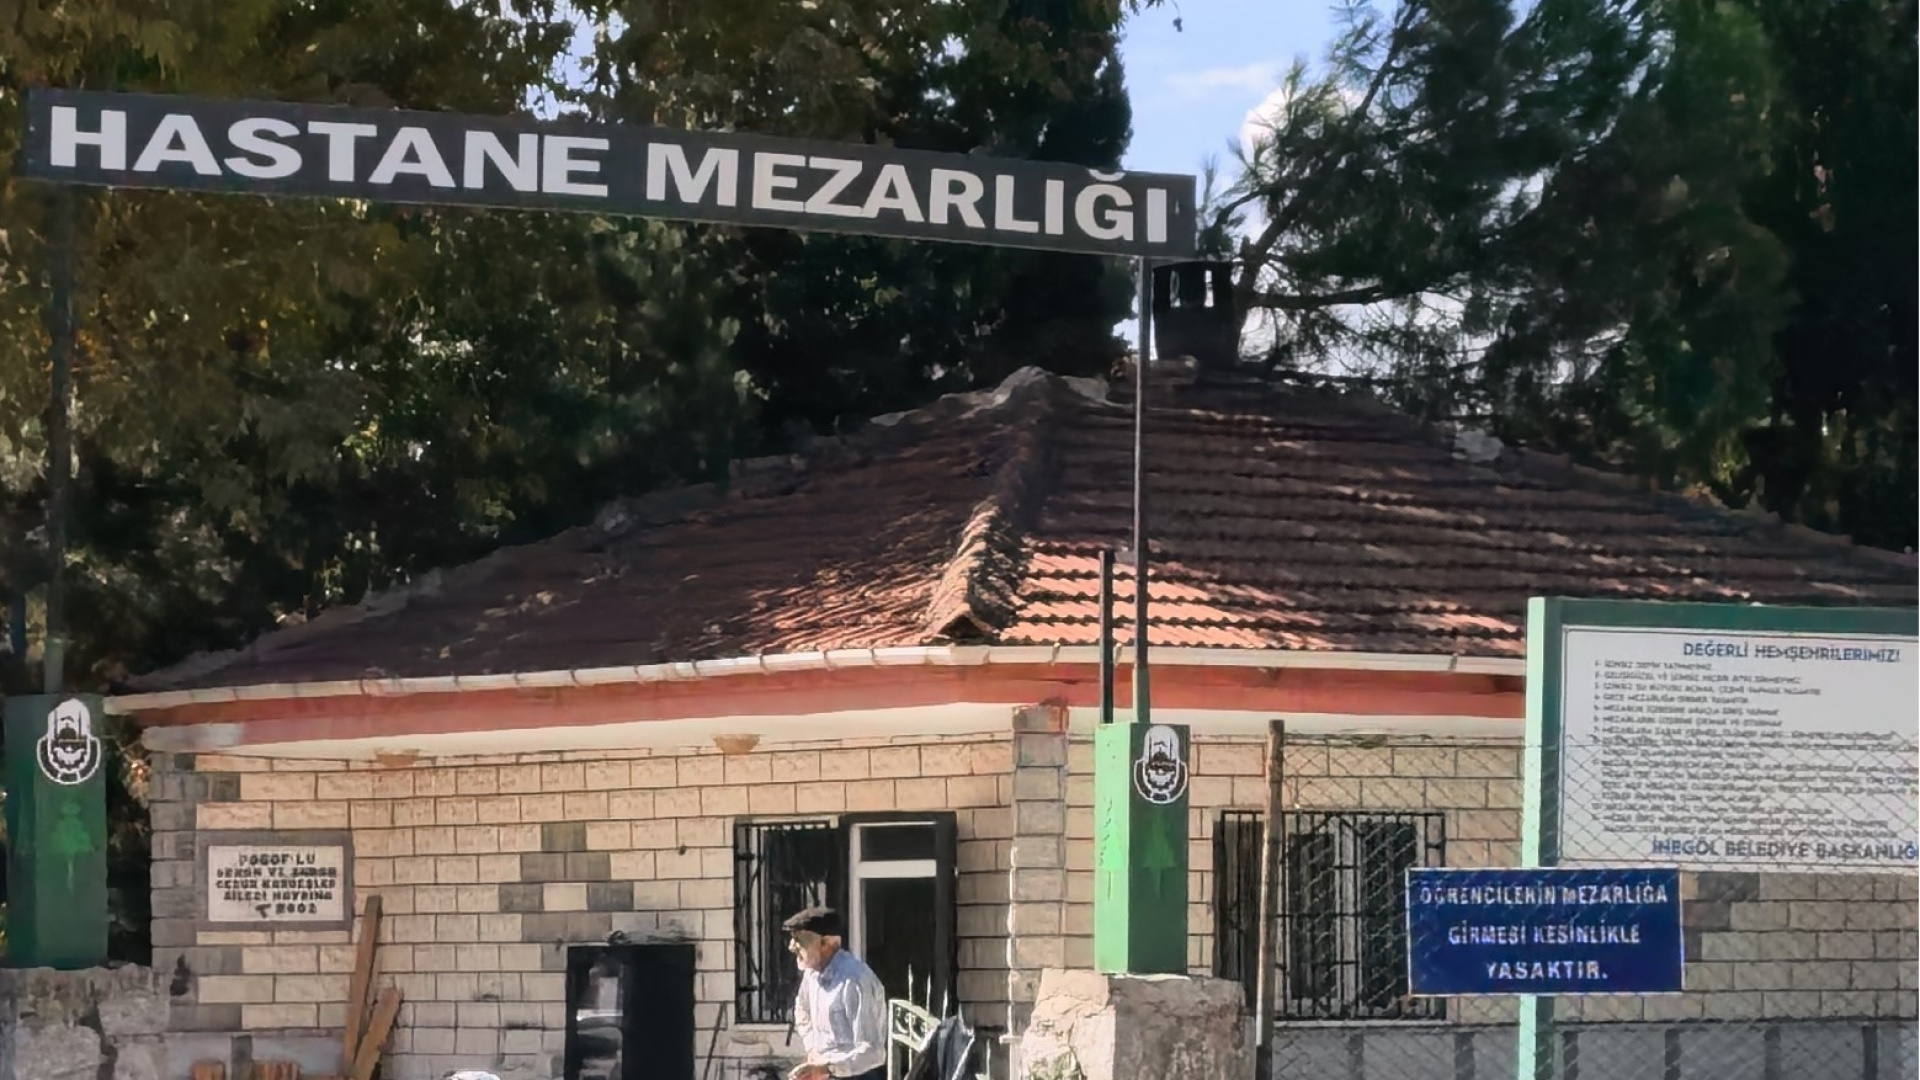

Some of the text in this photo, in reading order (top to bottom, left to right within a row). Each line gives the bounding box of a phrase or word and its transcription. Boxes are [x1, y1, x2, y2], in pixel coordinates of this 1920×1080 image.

[50, 106, 1168, 243] HASTANE MEZARLIĞI
[1683, 640, 1748, 658] DEĞERLİ
[1652, 836, 1719, 856] İNEGÖL
[1725, 838, 1808, 858] BELEDİYE
[1419, 881, 1668, 905] ÖĞRENCİLERİN MEZARLIĞA
[276, 903, 317, 914] 2002
[1449, 920, 1641, 945] GİRMESİ KESİNLİKLE
[1486, 961, 1608, 980] YASAKTIR.
